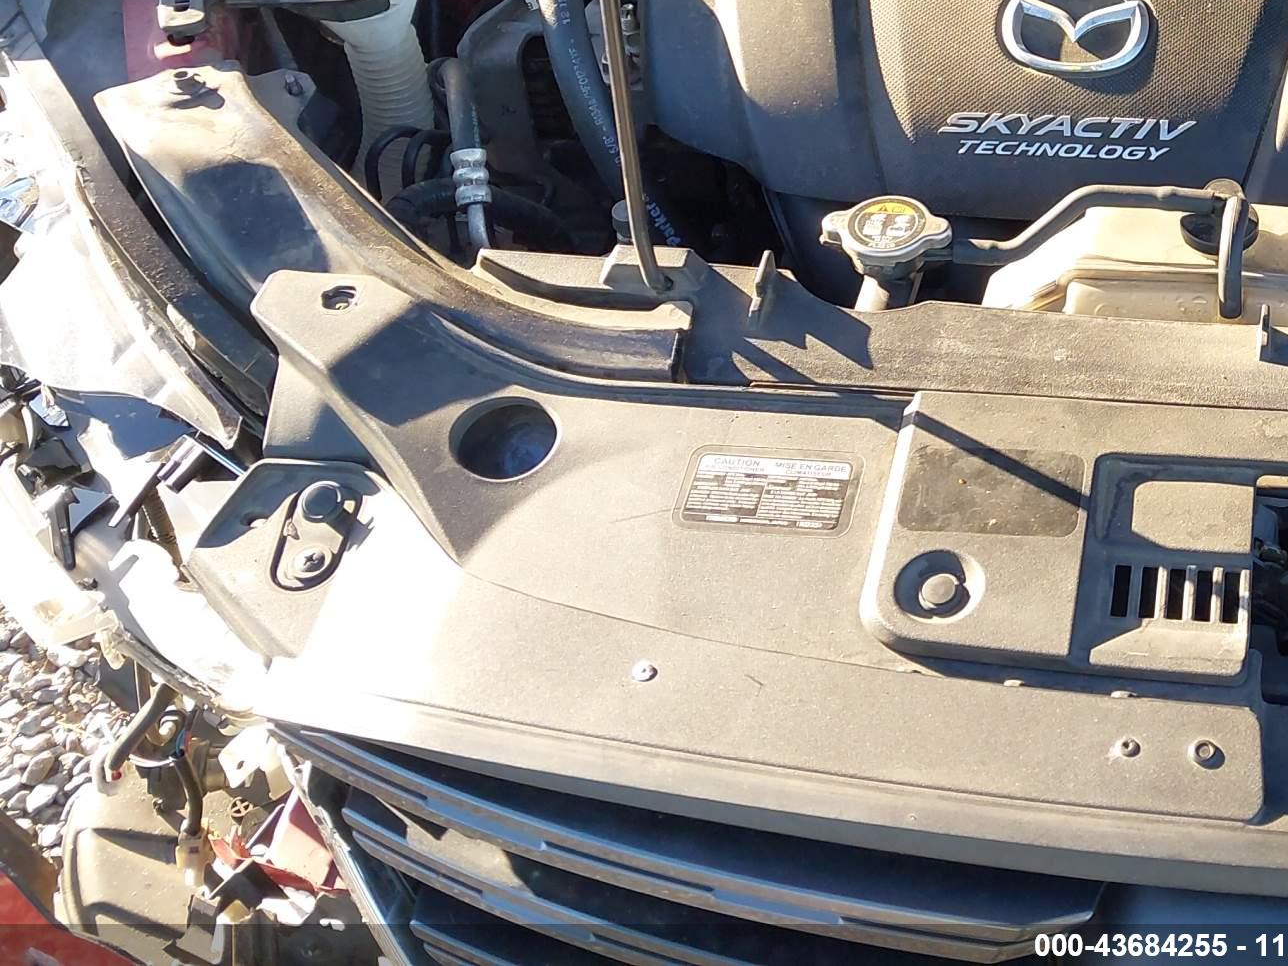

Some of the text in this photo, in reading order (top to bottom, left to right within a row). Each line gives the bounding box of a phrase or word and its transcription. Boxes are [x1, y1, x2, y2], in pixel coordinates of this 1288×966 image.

[937, 112, 1197, 141] SKYACTIV
[957, 139, 1170, 161] TECHNOLOGY
[646, 201, 681, 246] Parker
[714, 458, 761, 467] CAUTION
[799, 463, 812, 471] EN
[814, 465, 847, 473] GARDE
